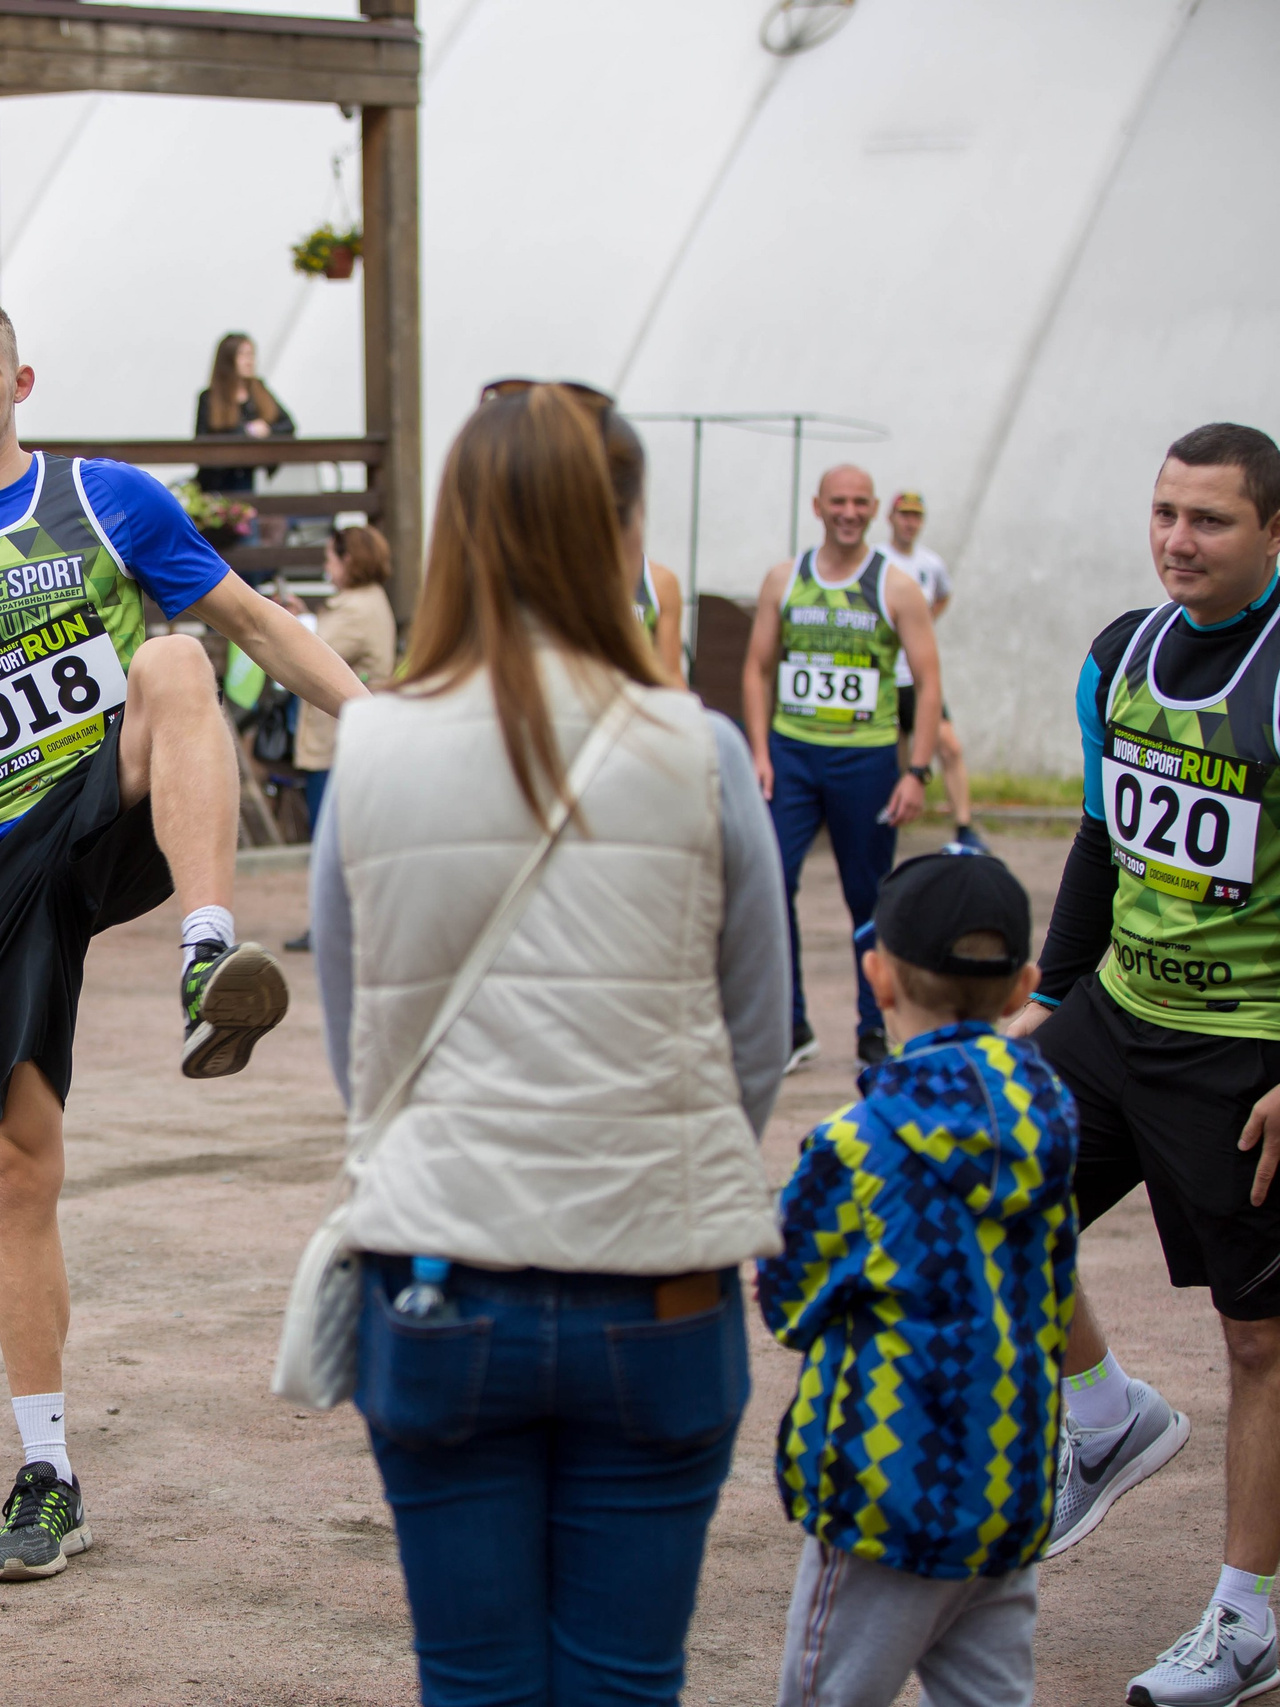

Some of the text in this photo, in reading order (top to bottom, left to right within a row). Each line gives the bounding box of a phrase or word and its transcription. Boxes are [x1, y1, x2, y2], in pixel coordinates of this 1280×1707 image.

[54, 588, 81, 600] ЗАБЕГ
[0, 641, 19, 656] ЗАБЕГ
[20, 613, 90, 661] RUN
[793, 670, 861, 702] 038
[46, 732, 82, 753] СОСНОВКА
[81, 723, 99, 737] ПАРК
[1163, 744, 1183, 756] ЗАБЕГ
[1113, 737, 1182, 777] WORK&SPORT
[1180, 750, 1247, 795] RUN
[1114, 773, 1230, 867] 020
[1149, 868, 1200, 892] СОСНОВКА ПАРК
